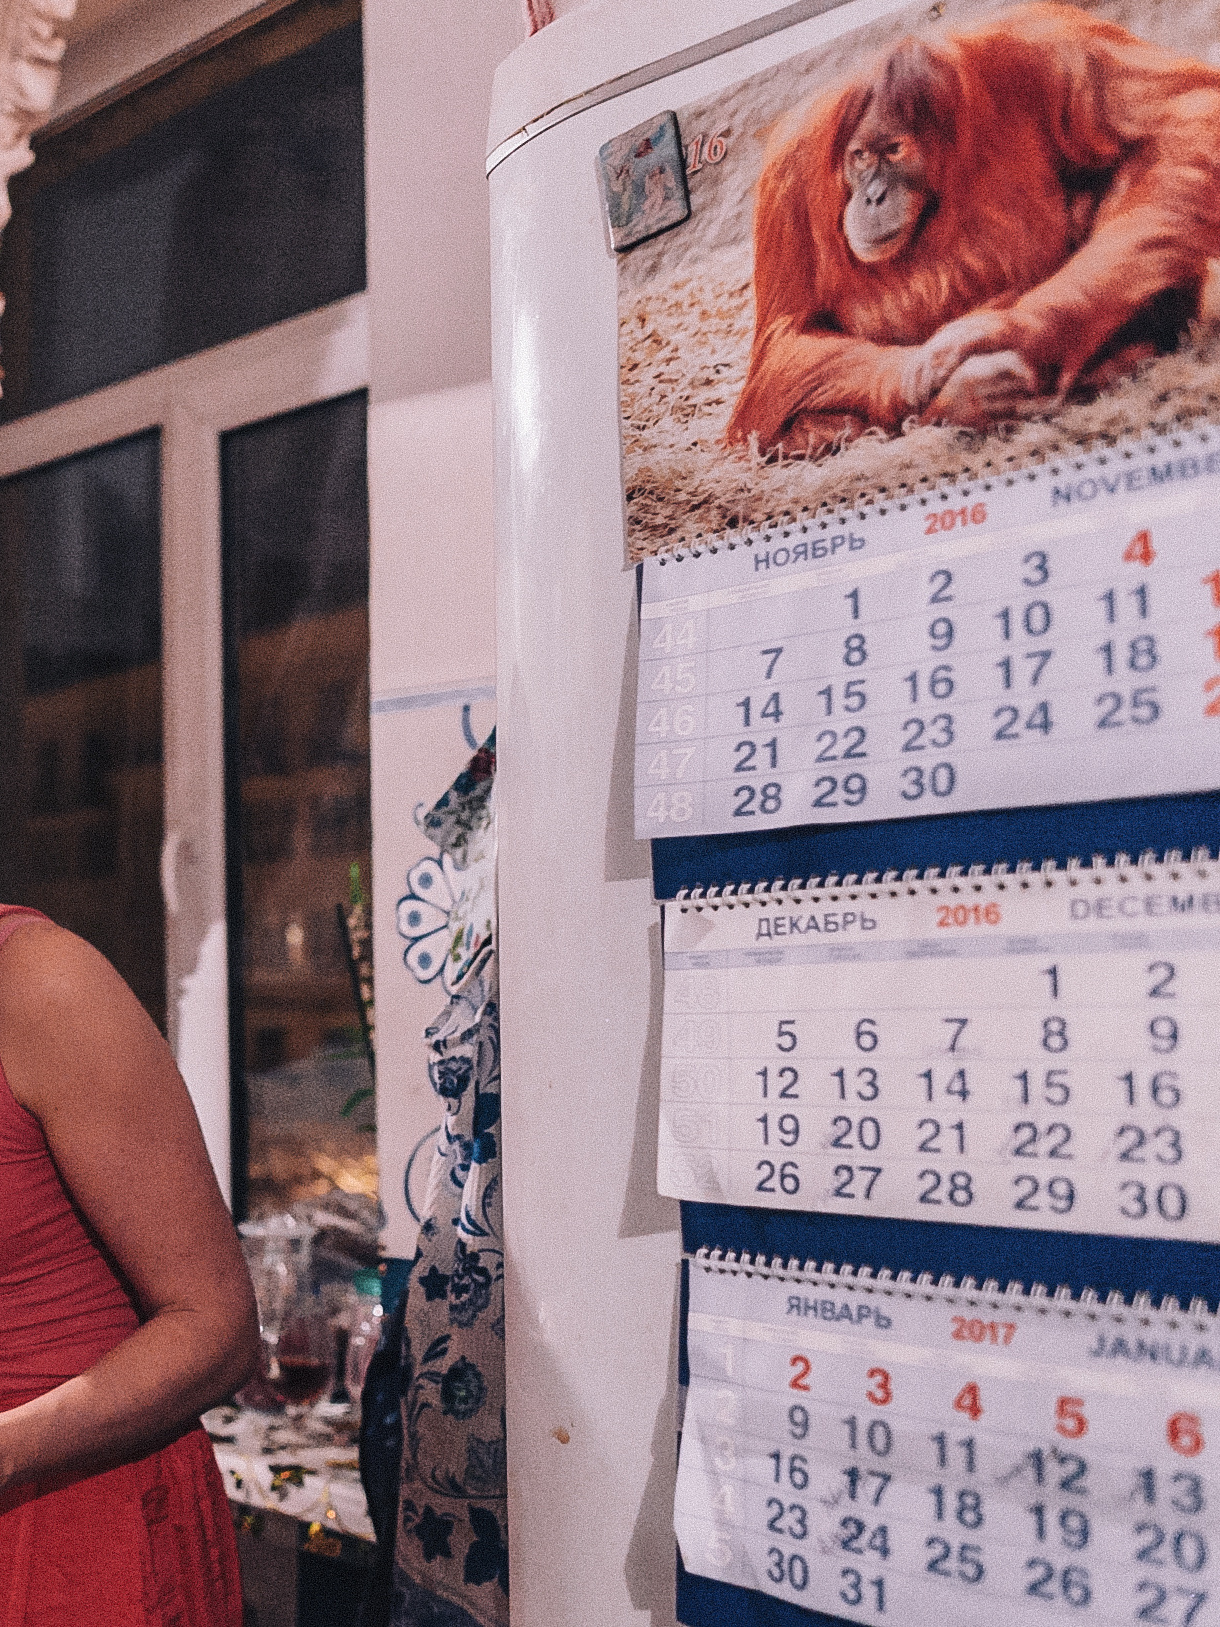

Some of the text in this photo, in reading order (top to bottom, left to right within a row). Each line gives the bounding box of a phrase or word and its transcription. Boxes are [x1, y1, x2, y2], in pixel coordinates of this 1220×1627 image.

[684, 129, 729, 174] 16
[925, 503, 987, 535] 2016
[754, 533, 867, 572] НОЯБРЬ
[845, 588, 860, 620] 1
[930, 569, 953, 604] 2
[1023, 551, 1050, 587] 3
[1124, 530, 1155, 566] 4
[761, 647, 784, 679] 7
[843, 633, 868, 667] 8
[929, 617, 955, 651] 9
[996, 600, 1052, 640] 10
[1100, 583, 1148, 624] 11
[737, 692, 783, 727] 14
[817, 679, 867, 716] 15
[904, 664, 955, 703] 16
[996, 649, 1053, 690] 17
[1098, 635, 1158, 676] 18
[734, 737, 778, 773] 21
[815, 726, 868, 763] 22
[902, 713, 955, 753] 23
[994, 701, 1053, 741] 24
[1096, 686, 1161, 730] 25
[732, 782, 782, 817] 28
[812, 773, 868, 808] 29
[900, 762, 957, 801] 30
[756, 912, 877, 940] ДЕКАБРЬ
[937, 902, 1001, 928] 2016
[1045, 965, 1059, 999] 1
[1148, 962, 1176, 998] 2
[777, 1020, 797, 1053] 5
[855, 1018, 879, 1052] 6
[944, 1018, 969, 1053] 7
[1041, 1016, 1069, 1053] 8
[1148, 1017, 1179, 1053] 9
[757, 1066, 799, 1099] 12
[831, 1067, 880, 1101] 13
[919, 1068, 970, 1102] 14
[1015, 1070, 1071, 1106] 15
[1119, 1071, 1181, 1109] 16
[757, 1113, 800, 1147] 19
[830, 1115, 881, 1151] 20
[917, 1118, 965, 1154] 21
[1012, 1121, 1072, 1159] 22
[1116, 1124, 1183, 1165] 23
[756, 1160, 1188, 1221] 26 27 28 29 30
[787, 1295, 892, 1330] ЯНВАРЬ
[952, 1316, 1016, 1345] 2017
[790, 1355, 811, 1391] 2
[867, 1368, 892, 1405] 3
[954, 1383, 982, 1420] 4
[1056, 1396, 1087, 1438] 5
[1167, 1413, 1203, 1456] 6
[788, 1405, 810, 1440] 9
[843, 1416, 893, 1458] 10
[931, 1432, 976, 1474] 11
[1027, 1447, 1087, 1495] 12
[1135, 1467, 1204, 1515] 13
[768, 1450, 809, 1490] 16
[843, 1466, 892, 1505] 17
[929, 1484, 984, 1530] 18
[1028, 1501, 1090, 1550] 19
[1134, 1521, 1207, 1572] 20
[767, 1498, 809, 1540] 23
[836, 1516, 890, 1560] 24
[926, 1537, 985, 1584] 25
[1026, 1558, 1092, 1607] 26
[1136, 1580, 1208, 1627] 27
[767, 1547, 809, 1591] 30
[840, 1568, 885, 1613] 31
